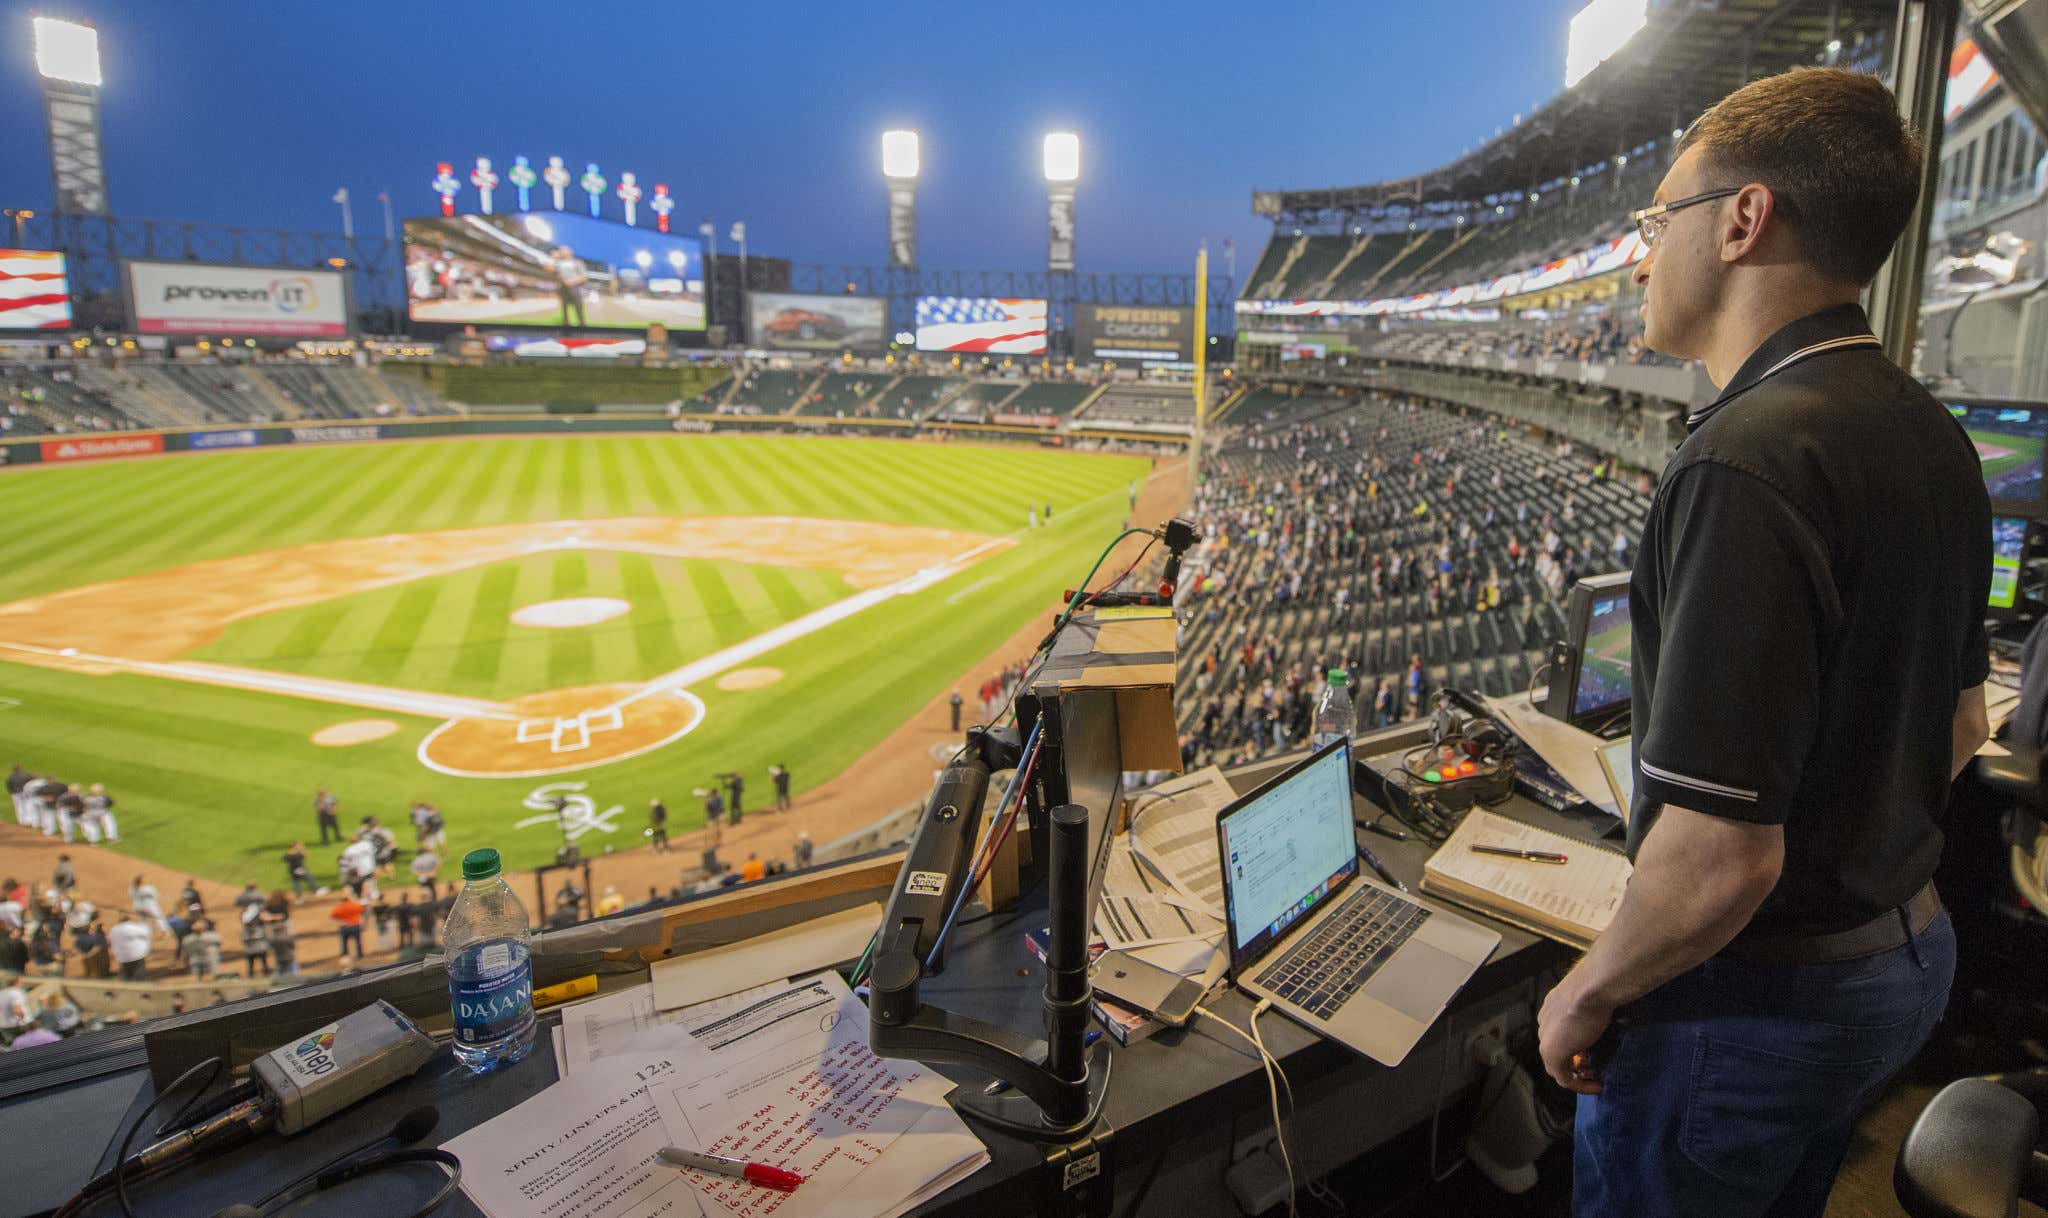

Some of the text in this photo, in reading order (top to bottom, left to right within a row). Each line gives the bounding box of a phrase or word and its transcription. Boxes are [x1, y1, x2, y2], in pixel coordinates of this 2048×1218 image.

[164, 284, 304, 303] proven IT
[460, 980, 532, 1018] DASANI
[301, 1047, 335, 1075] nep
[634, 1059, 673, 1082] 12a
[504, 1142, 555, 1176] XFINITY
